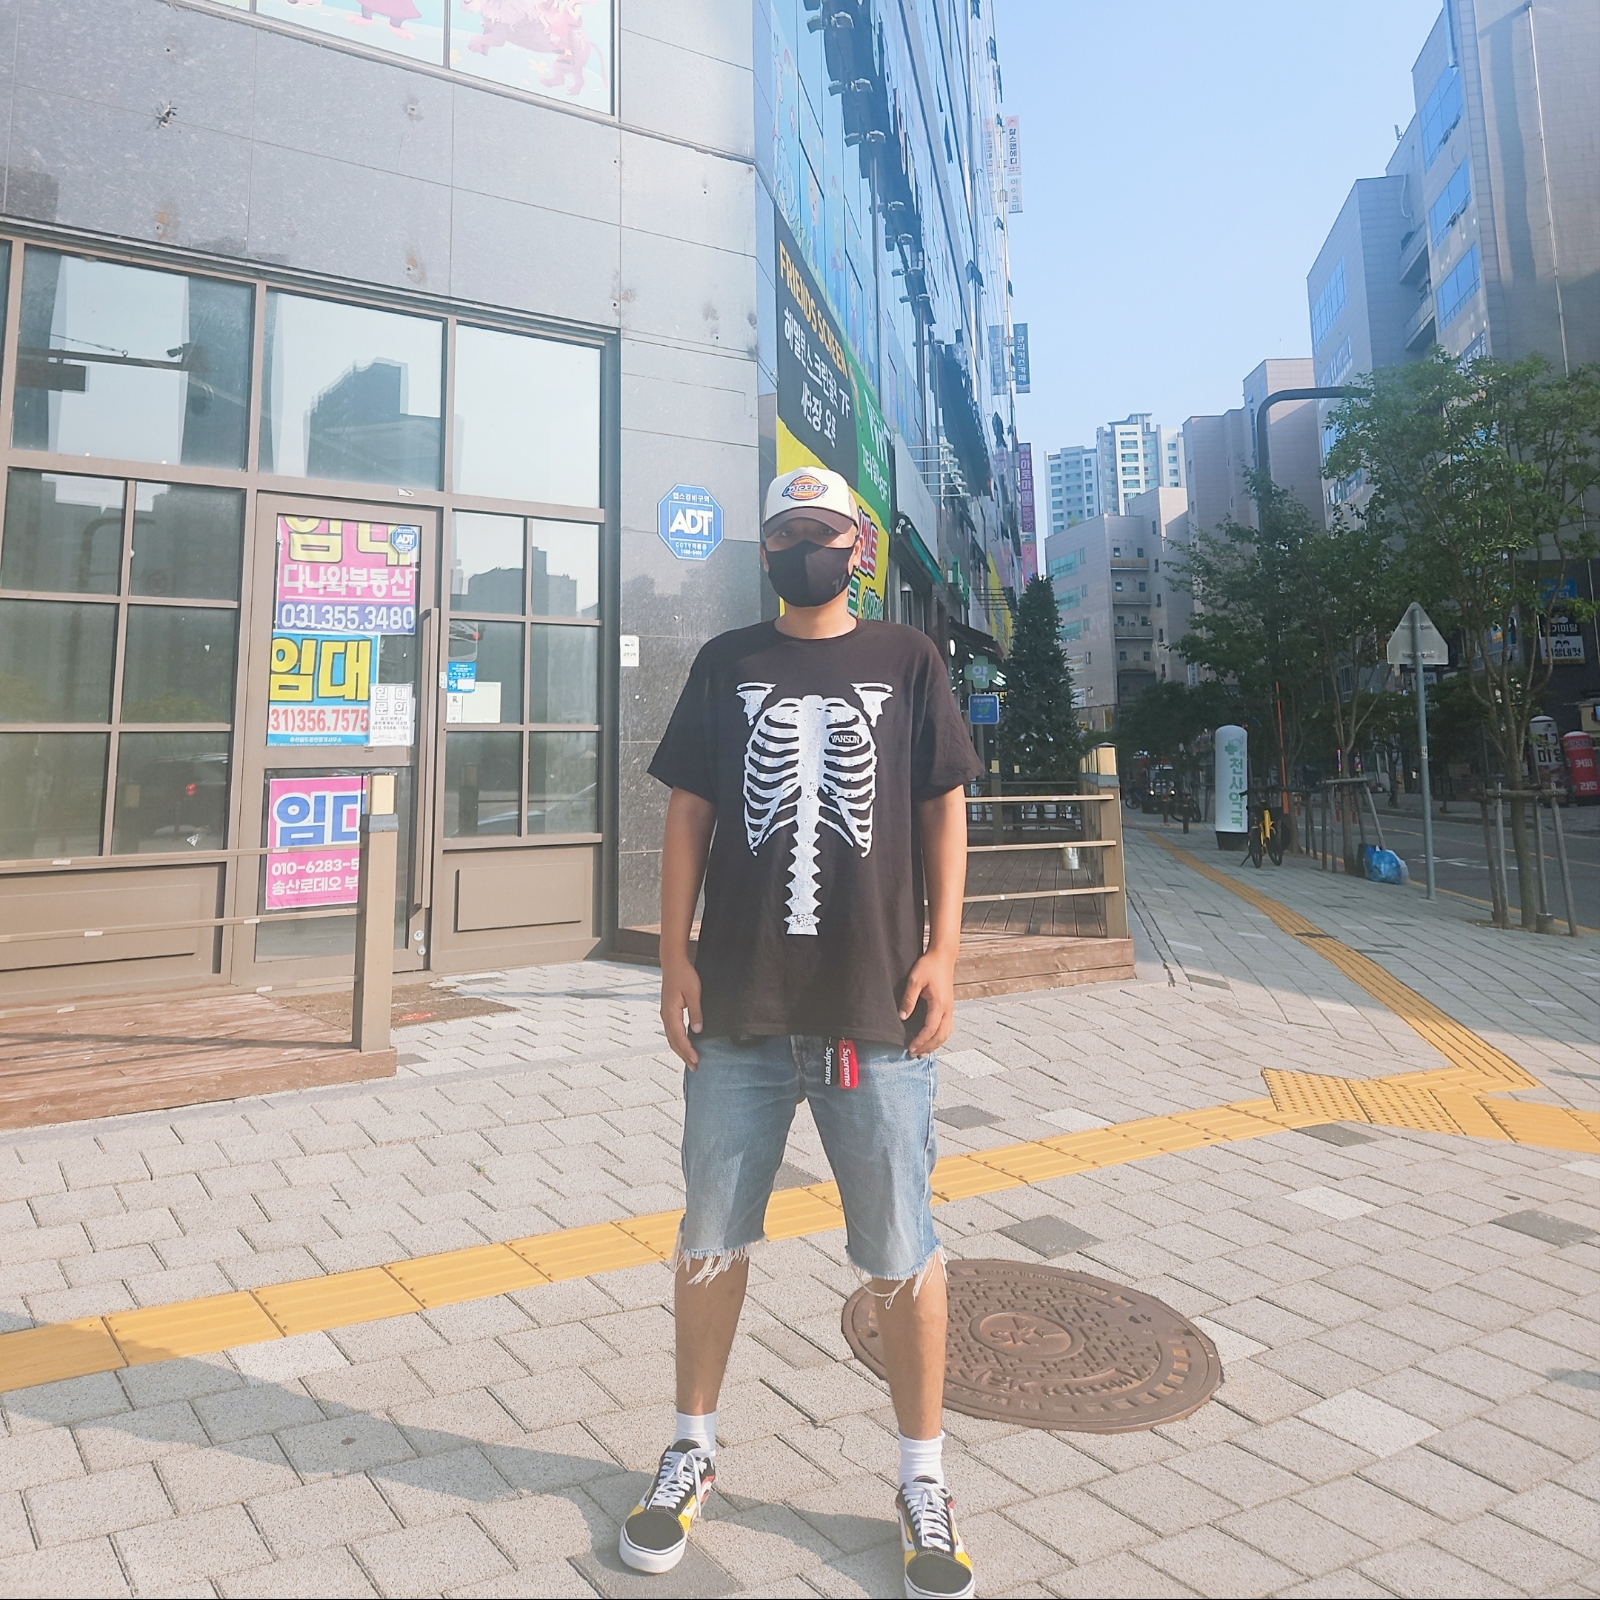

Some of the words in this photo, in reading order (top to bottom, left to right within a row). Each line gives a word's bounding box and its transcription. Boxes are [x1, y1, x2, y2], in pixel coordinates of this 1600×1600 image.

[779, 239, 817, 333] FRIENDS
[817, 308, 849, 380] SCREEN
[670, 508, 713, 536] ADT
[395, 533, 415, 545] ADT
[283, 564, 413, 597] 다나와부동산
[281, 603, 415, 630] 031.355.3480
[269, 637, 372, 702] 임대
[830, 734, 860, 744] VANSON
[1228, 757, 1244, 828] 천사약국
[271, 876, 342, 896] 송산로데오
[823, 1046, 834, 1085] Supreme
[841, 1048, 851, 1087] Supreme
